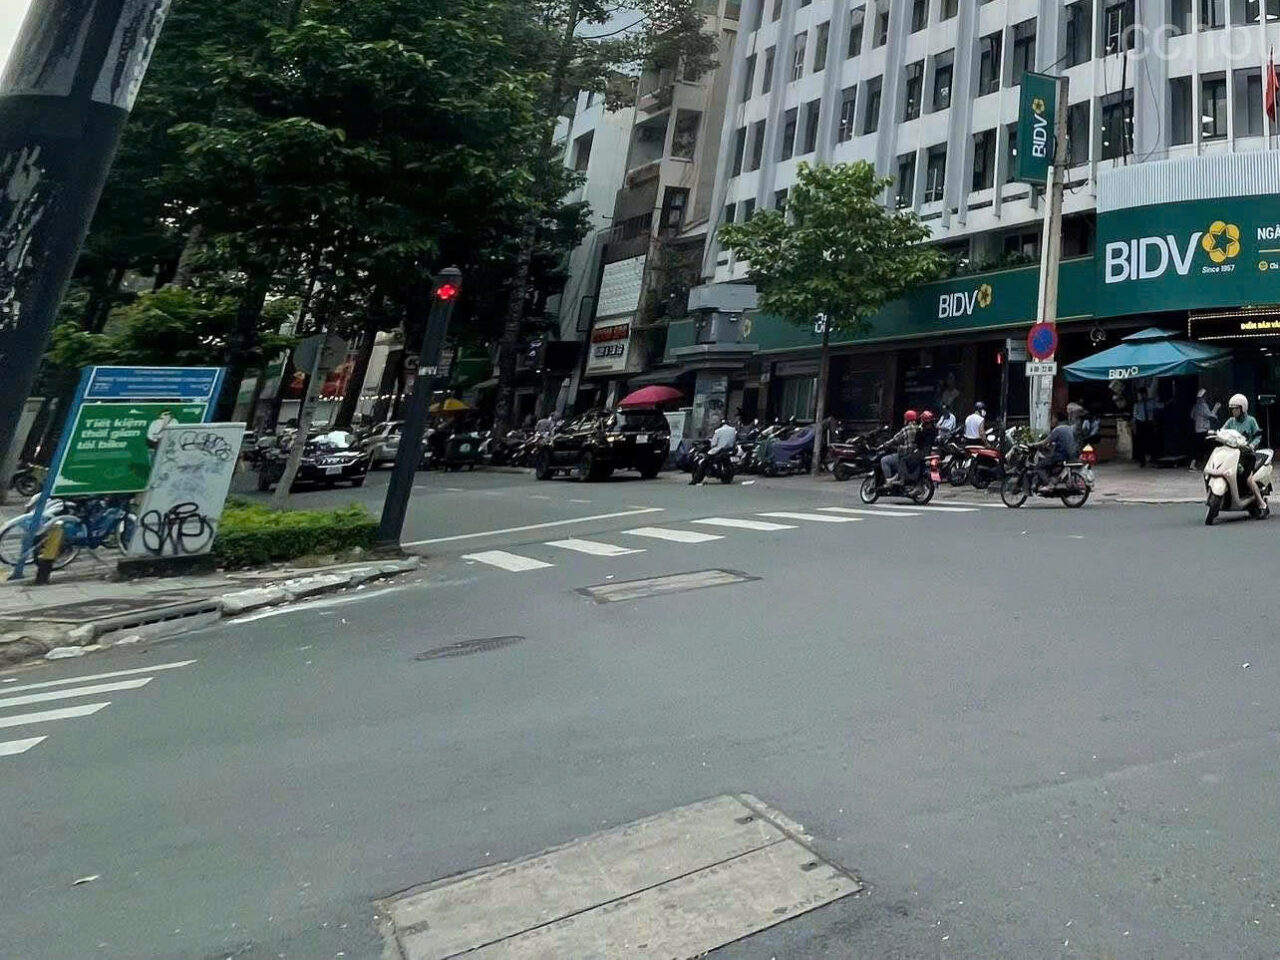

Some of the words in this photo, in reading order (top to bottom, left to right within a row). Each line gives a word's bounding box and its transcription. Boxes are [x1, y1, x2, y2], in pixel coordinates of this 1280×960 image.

[1033, 113, 1047, 157] BIDV
[1105, 231, 1203, 284] BIDV
[939, 290, 979, 318] BIDV
[1109, 368, 1131, 379] BIDV
